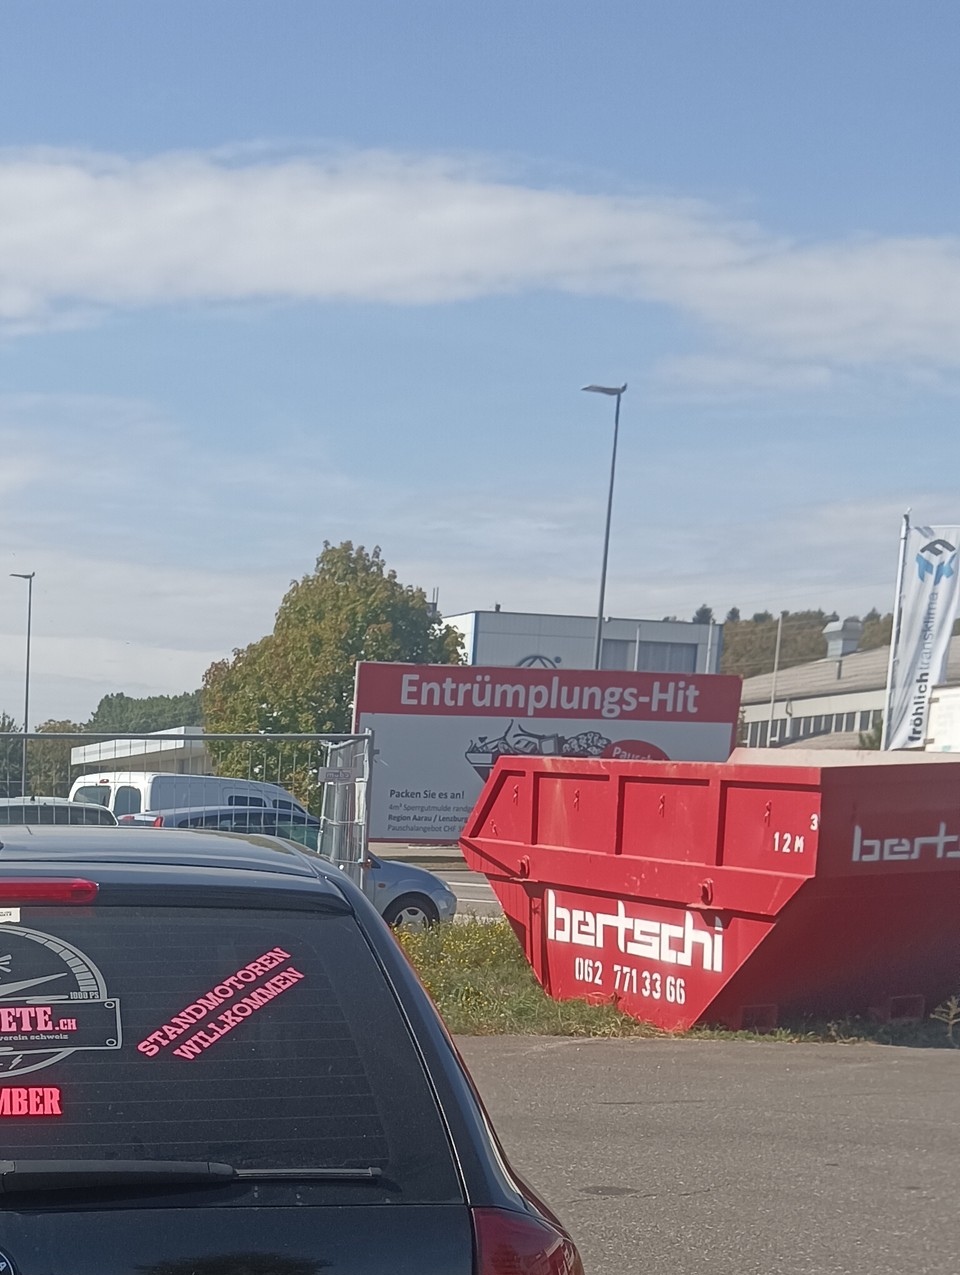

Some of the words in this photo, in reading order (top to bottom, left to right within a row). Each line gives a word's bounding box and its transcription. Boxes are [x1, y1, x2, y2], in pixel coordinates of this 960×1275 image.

[400, 673, 700, 718] Entrümplungs-Hit
[389, 789, 421, 799] Packen
[423, 790, 436, 799] Sie
[450, 791, 465, 799] an!
[403, 804, 451, 813] Sperrgutmulde
[388, 814, 410, 822] Region
[809, 812, 820, 832] 3
[387, 824, 442, 833] Pauschalangebot
[546, 888, 724, 972] bertschi
[574, 957, 603, 986] 062
[613, 964, 639, 995] 771
[641, 971, 662, 999] 33
[665, 976, 686, 1005] 66
[69, 991, 87, 1000] 1000
[88, 991, 100, 999] PS
[137, 947, 292, 1057] STANDMOTOREN
[172, 966, 305, 1060] WILLKOMMEN
[30, 1033, 69, 1041] schweiz
